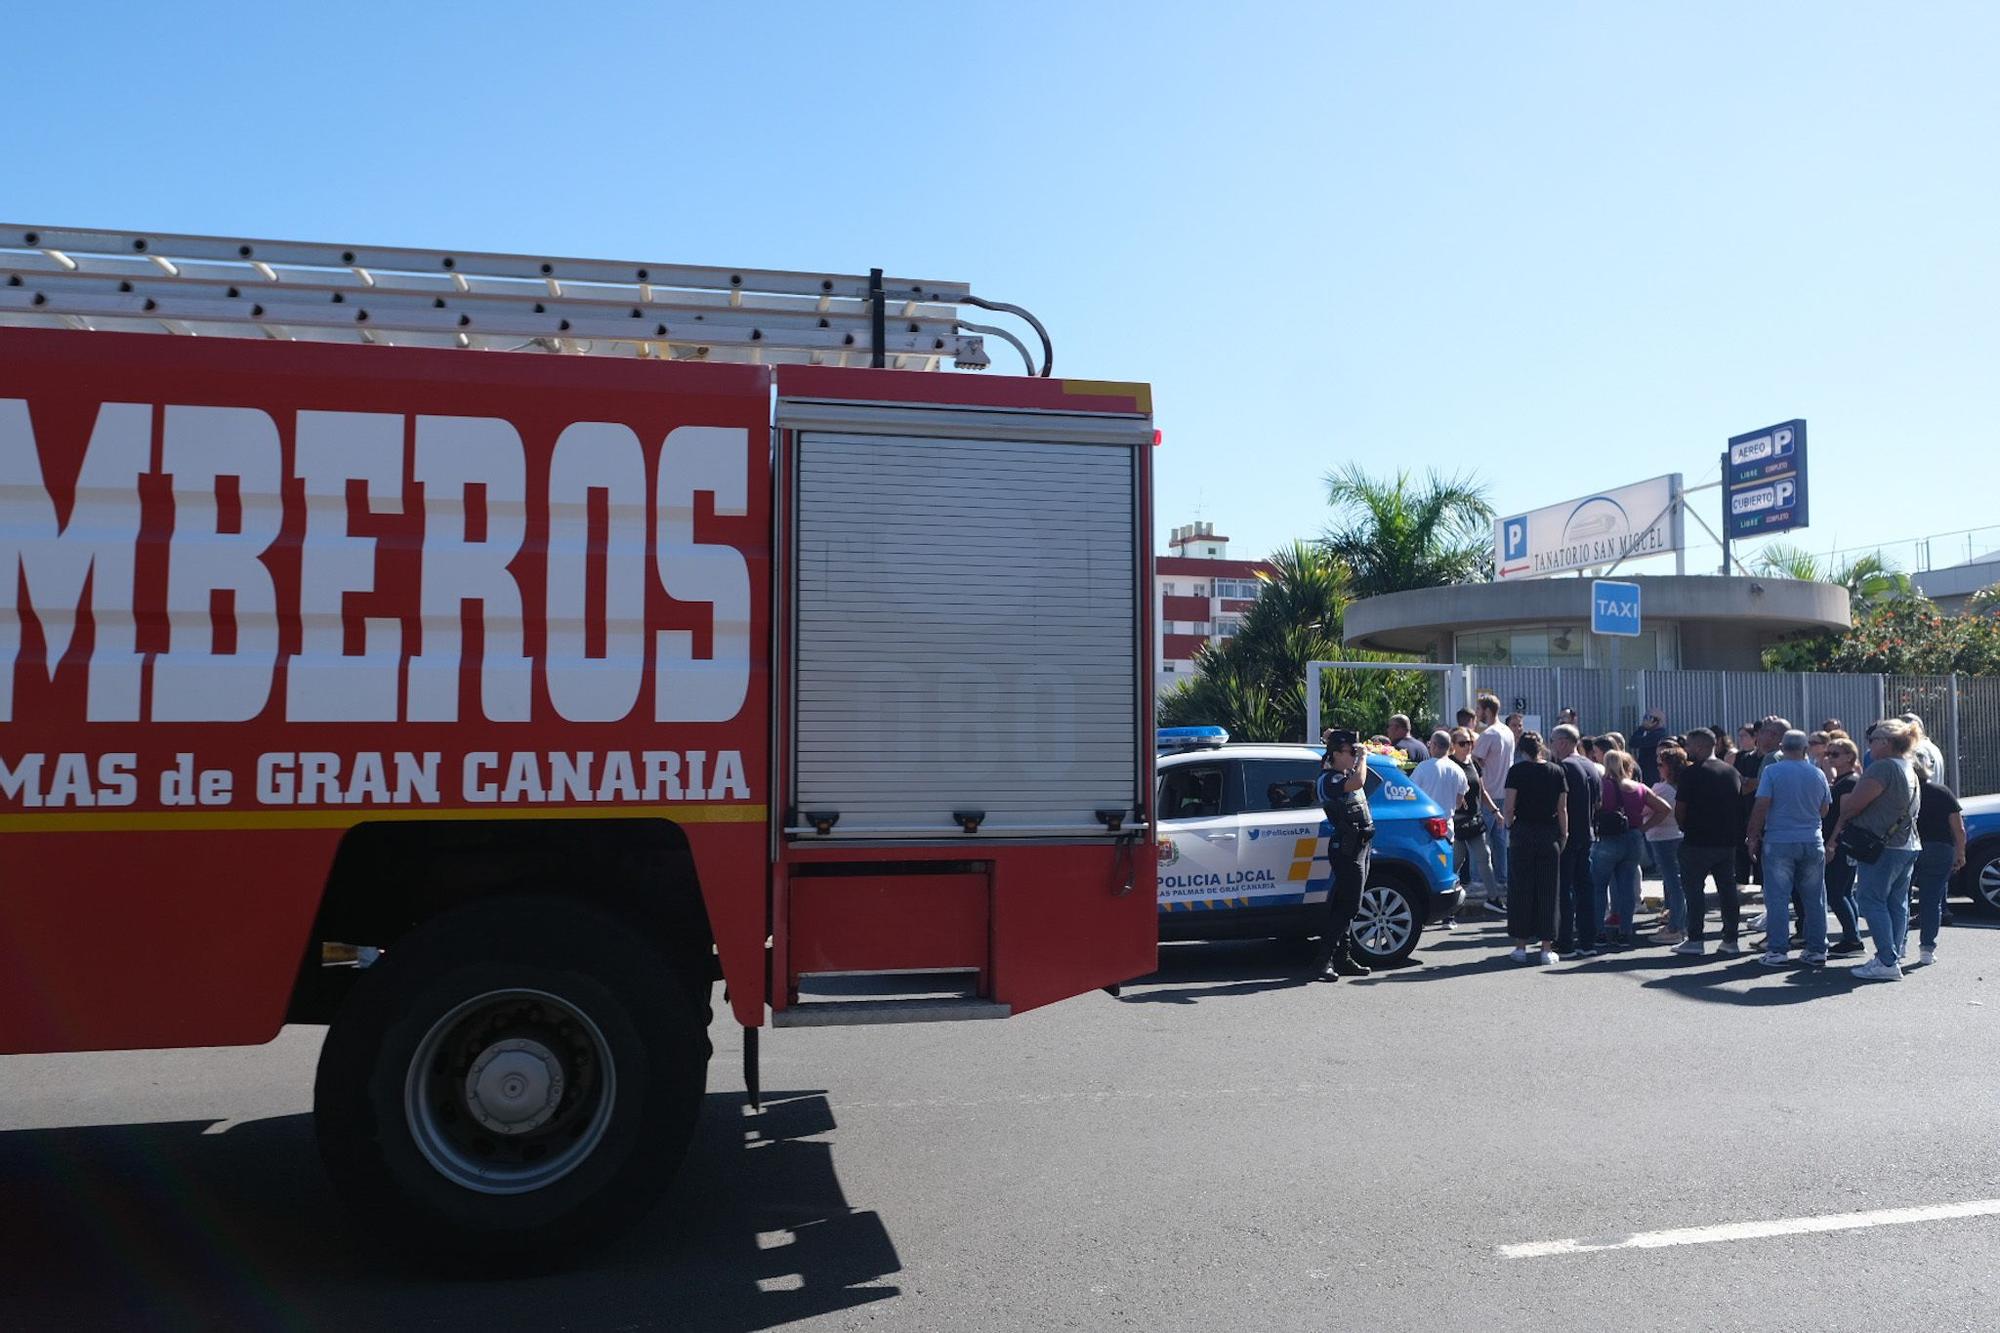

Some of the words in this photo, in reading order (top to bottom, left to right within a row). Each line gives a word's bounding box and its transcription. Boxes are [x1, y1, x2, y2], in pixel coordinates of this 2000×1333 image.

[1775, 430, 1792, 455] P
[1733, 493, 1773, 510] CUBIERTO
[1777, 481, 1793, 506] P
[1509, 524, 1522, 555] P
[1534, 543, 1590, 572] TANATORIO
[1594, 536, 1616, 561] SAN
[1620, 528, 1664, 556] MIGUEL
[0, 398, 750, 722] MBEROS
[1596, 600, 1638, 619] TAXI
[160, 753, 235, 805] de
[257, 751, 441, 804] GRAN
[463, 750, 750, 802] CANARIA
[1390, 786, 1415, 797] 092
[1173, 888, 1204, 896] PALMAS
[1241, 882, 1275, 891] CANARIA
[1226, 869, 1275, 884] LOCAL
